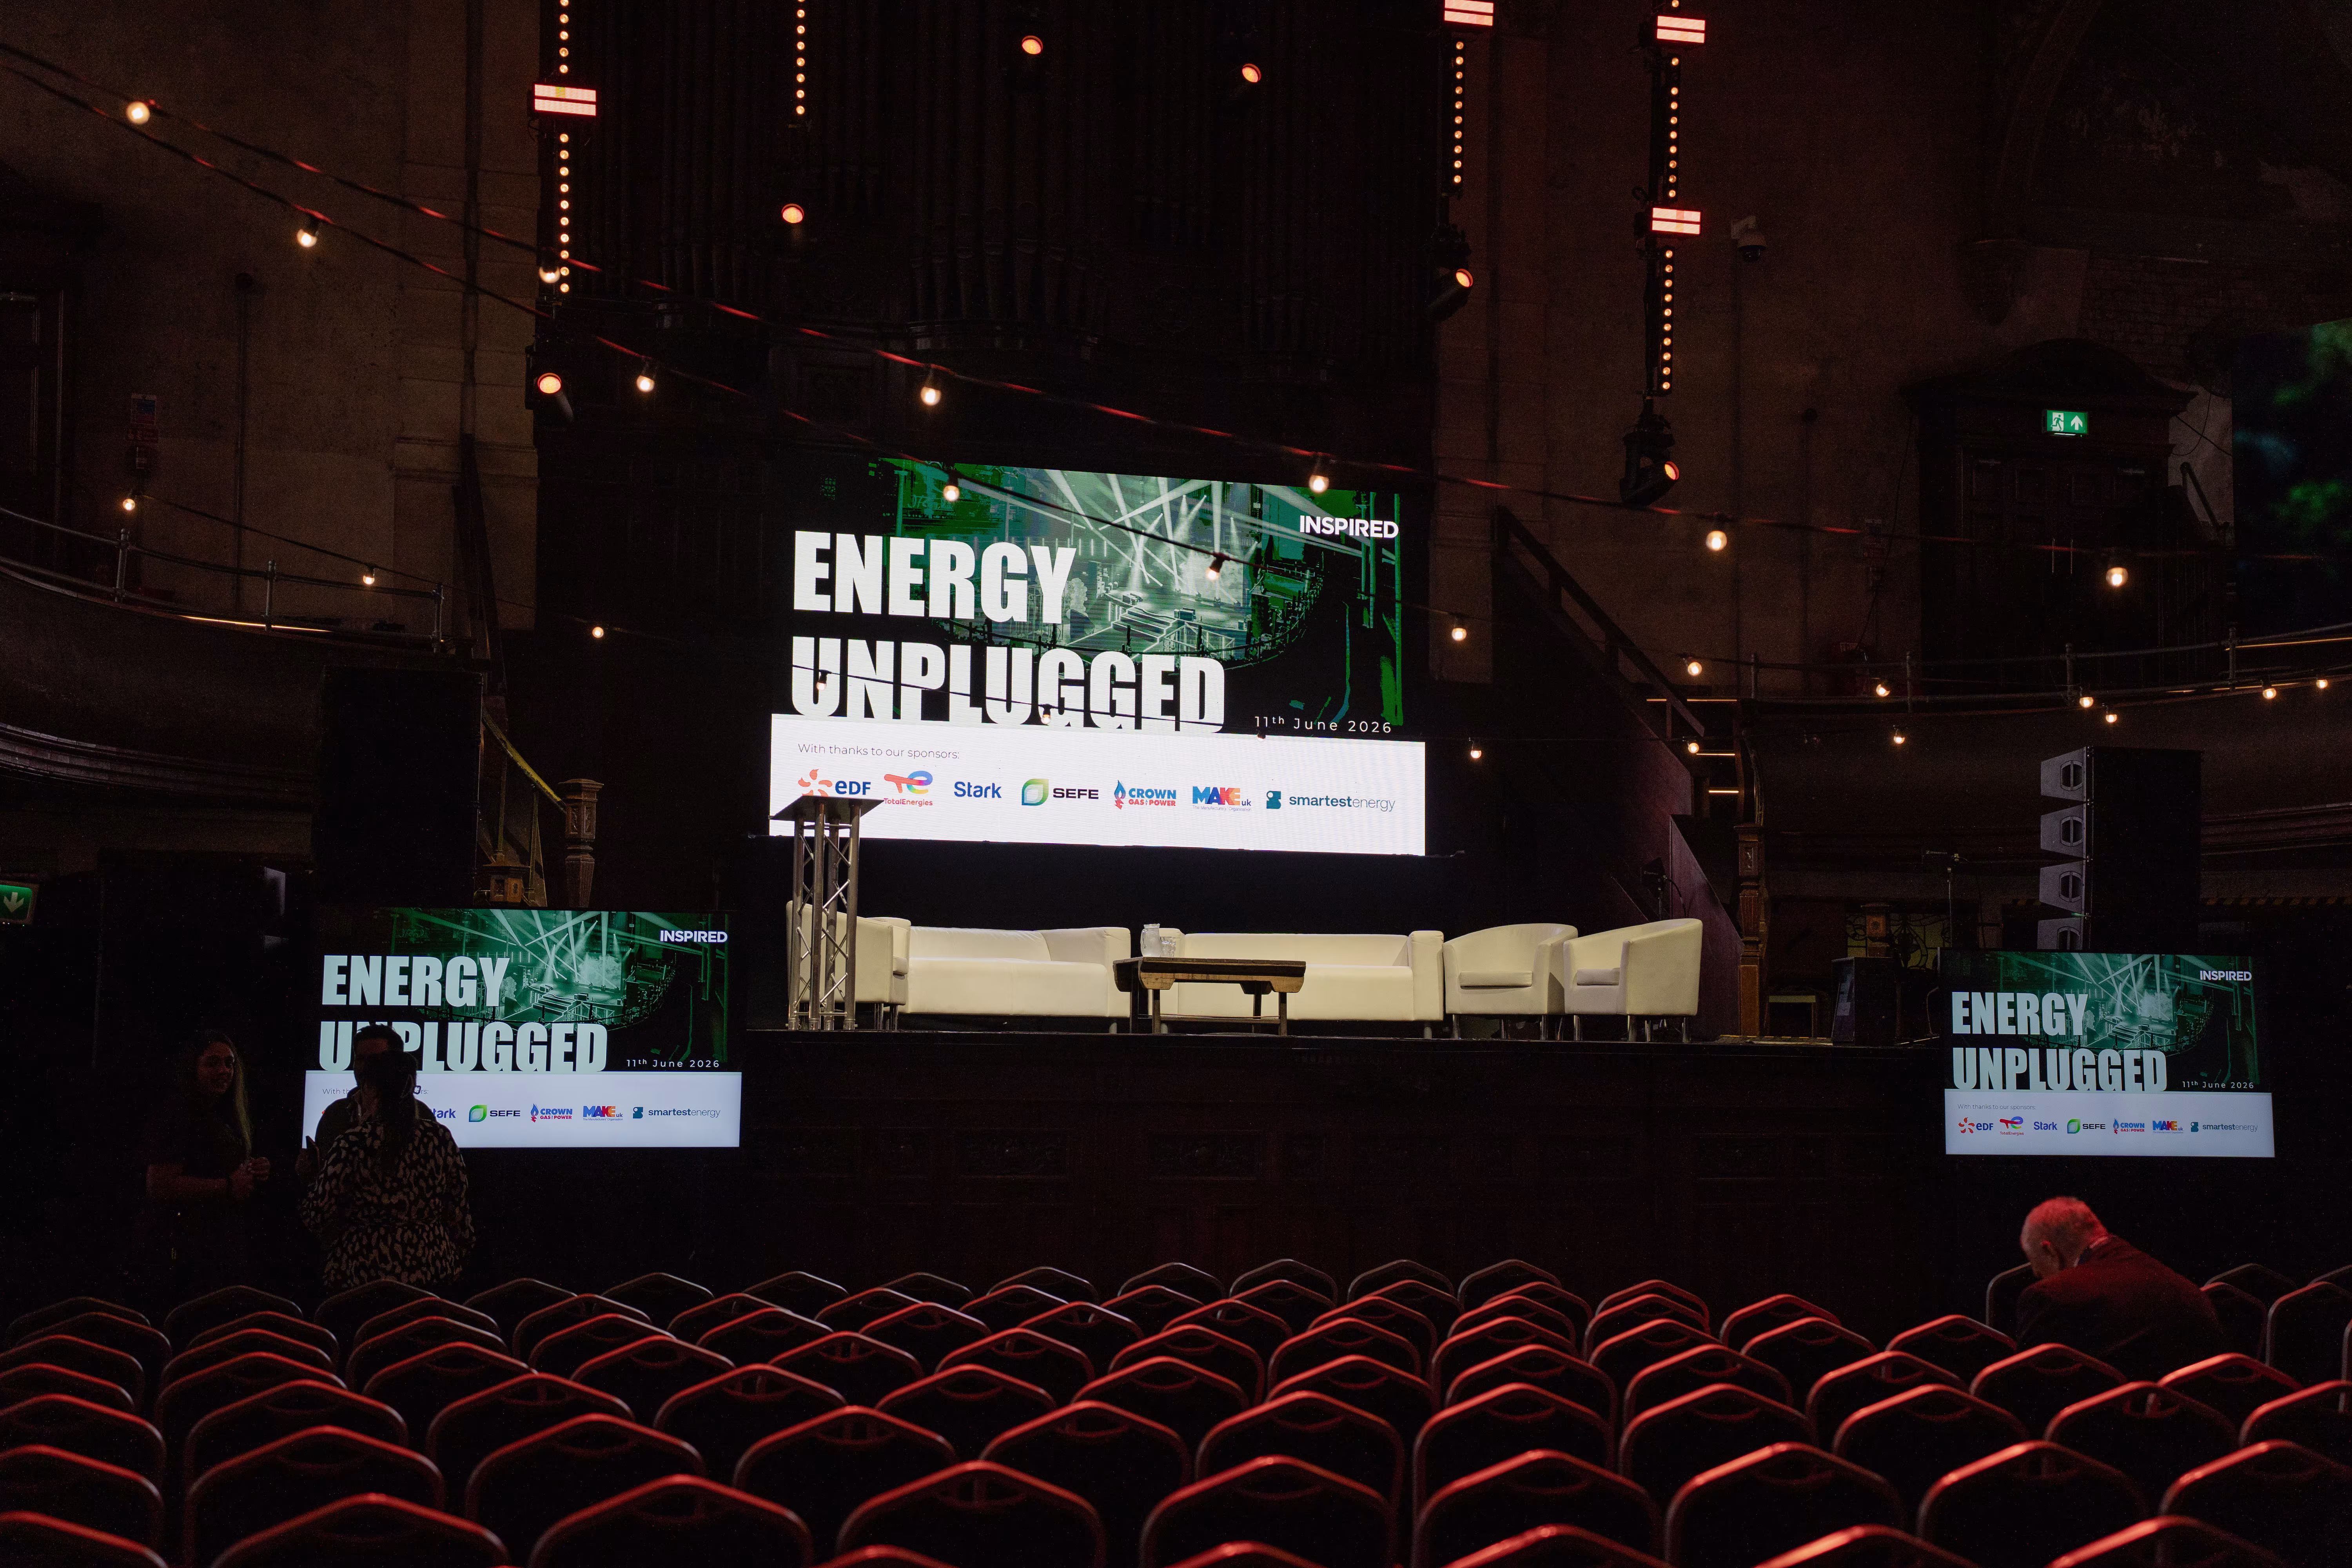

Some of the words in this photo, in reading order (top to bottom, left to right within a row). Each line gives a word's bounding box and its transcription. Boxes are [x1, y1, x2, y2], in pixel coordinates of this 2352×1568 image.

[1300, 514, 1399, 539] INSPIRED
[793, 530, 1077, 625] ENERGY
[791, 636, 1225, 735] UNPLUGGED
[1255, 716, 1285, 728] 11th
[1293, 718, 1338, 731] June
[1348, 720, 1392, 733] 2026
[798, 743, 826, 754] With
[829, 745, 868, 755] thanks
[871, 747, 883, 756] to
[886, 748, 905, 757] our
[907, 749, 960, 760] sponsors:
[954, 781, 1002, 799] Stark
[1053, 788, 1099, 799] SEFE
[1129, 788, 1176, 800] CROWN
[1192, 786, 1240, 806] MAKE
[883, 798, 933, 807] TotalEnergies
[1289, 796, 1396, 812] smartestenergy
[660, 930, 728, 942] INSPIRED
[322, 955, 510, 1007] ENERGY
[2200, 970, 2252, 981] INSPIRED
[1951, 991, 2088, 1036] ENERGY
[319, 1021, 608, 1072] UPLUGGED
[626, 1059, 647, 1067] 11th
[1953, 1047, 2167, 1091] UNPLUGGED
[433, 1108, 456, 1118] tark
[583, 1106, 616, 1117] MAKE
[648, 1108, 720, 1118] smartestenergy
[2033, 1121, 2058, 1130] Stark
[2152, 1121, 2177, 1131] MAKE
[2202, 1124, 2258, 1132] smartestenergy
